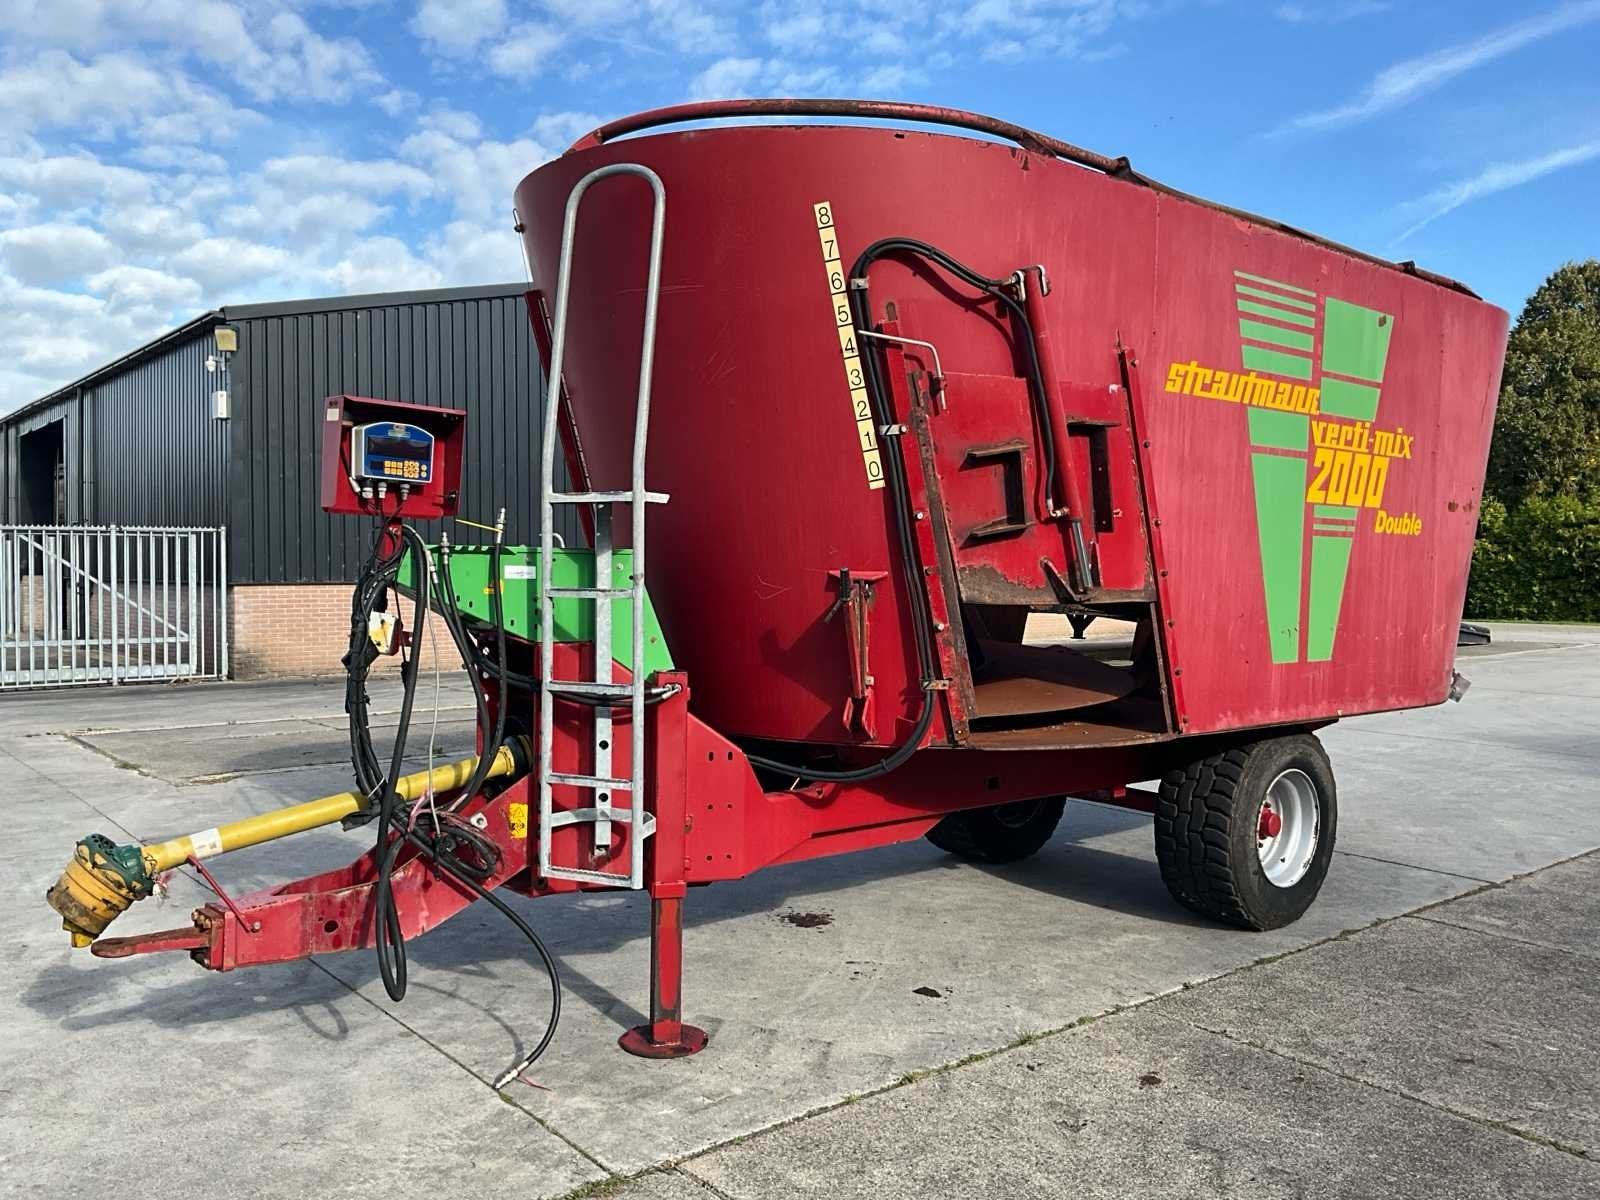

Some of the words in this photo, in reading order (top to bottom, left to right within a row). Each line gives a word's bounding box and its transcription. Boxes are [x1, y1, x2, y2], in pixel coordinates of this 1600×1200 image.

[819, 206, 831, 225] 8
[823, 240, 835, 258] 7
[831, 271, 843, 291] 6
[837, 306, 849, 323] 5
[843, 338, 856, 355] 4
[850, 369, 862, 387] 3
[856, 401, 868, 418] 2
[864, 432, 874, 448] 1
[868, 461, 880, 478] 0
[1306, 448, 1390, 509] 2000
[1375, 509, 1422, 537] Double
